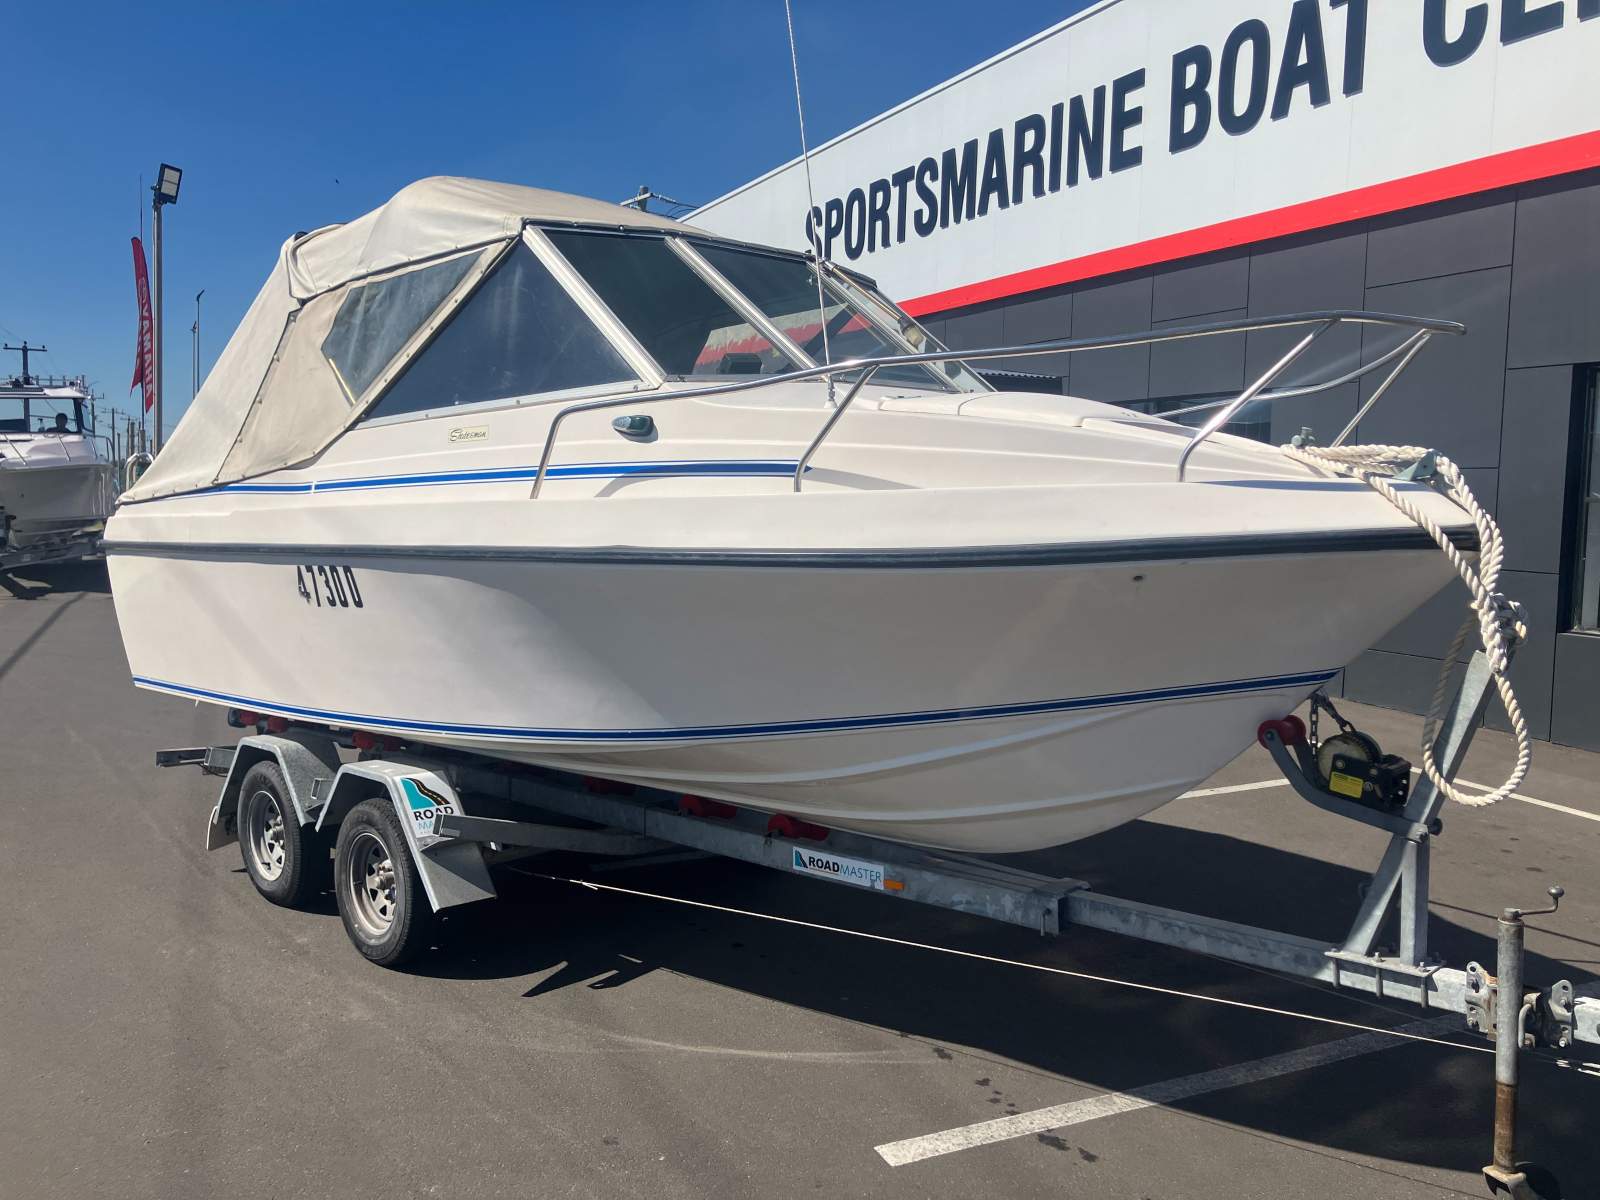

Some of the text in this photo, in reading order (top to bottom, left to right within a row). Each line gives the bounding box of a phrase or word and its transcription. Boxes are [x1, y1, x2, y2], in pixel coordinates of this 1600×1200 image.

[805, 0, 1368, 262] SPORTSMARINE BOAT
[142, 304, 152, 397] YAMAHA
[808, 856, 882, 882] ROADMASTER
